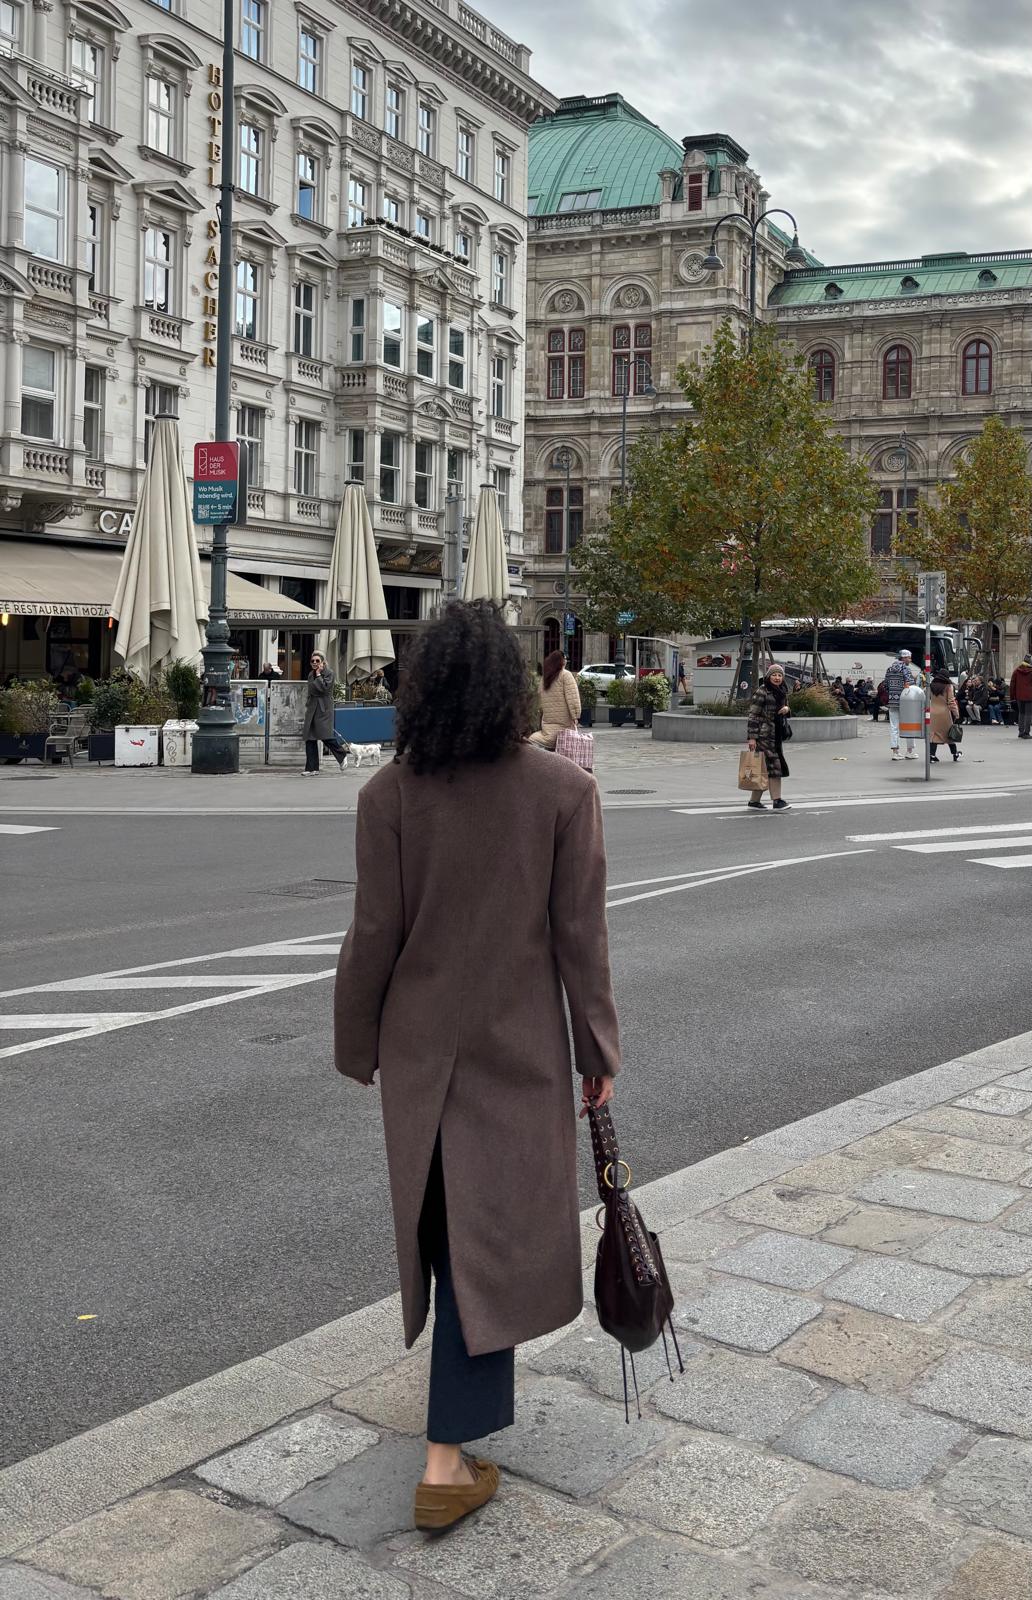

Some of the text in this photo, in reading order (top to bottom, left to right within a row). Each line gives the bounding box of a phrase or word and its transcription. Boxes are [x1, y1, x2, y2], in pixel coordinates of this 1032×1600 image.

[203, 63, 222, 368] HOTEL SACHER
[13, 604, 79, 615] RESTAURANT
